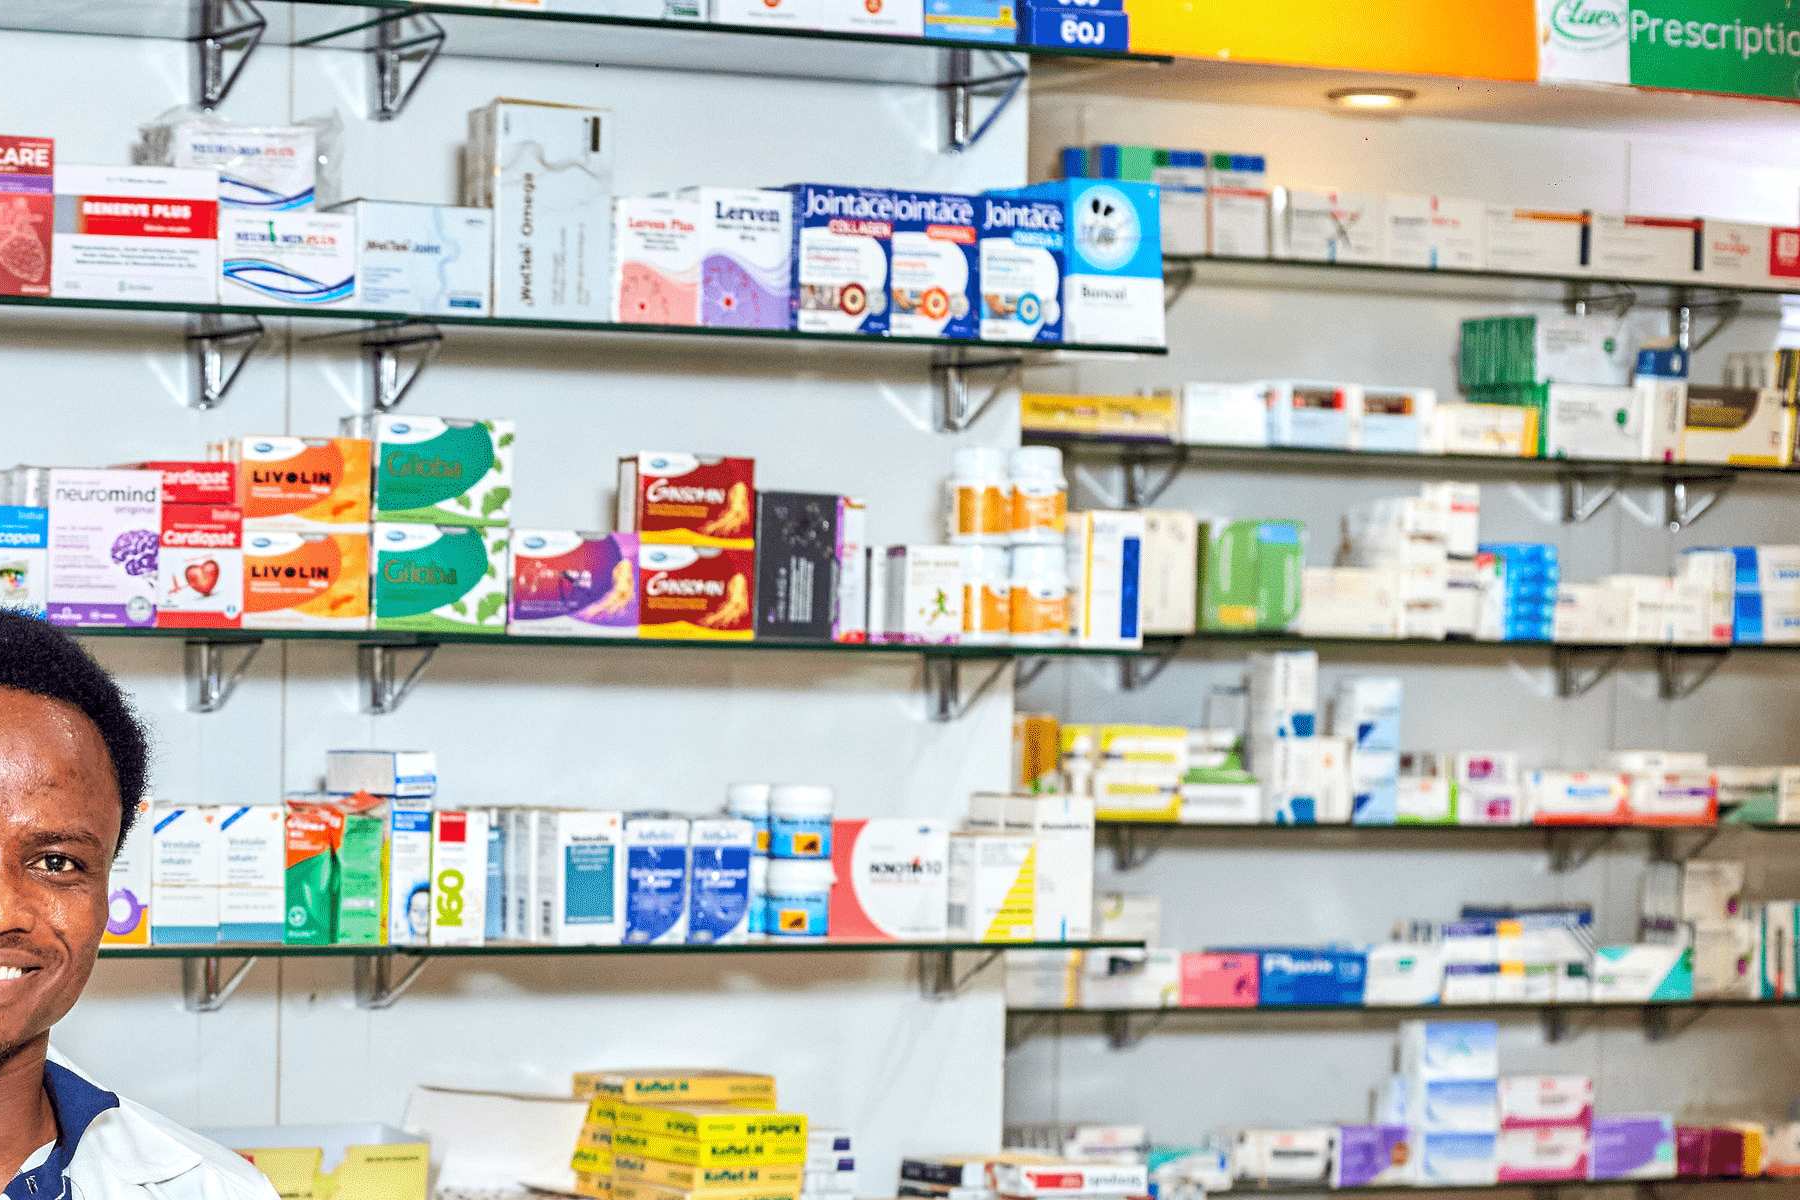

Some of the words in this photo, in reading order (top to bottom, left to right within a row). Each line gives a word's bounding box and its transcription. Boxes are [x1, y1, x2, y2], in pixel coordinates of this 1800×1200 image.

[153, 203, 192, 219] PLUS
[715, 200, 780, 223] Lerven
[804, 190, 891, 220] Jointace
[983, 200, 1064, 231] Jointace
[671, 219, 697, 233] Plus
[56, 484, 158, 505] neuromind
[163, 530, 235, 548] Cardiopat
